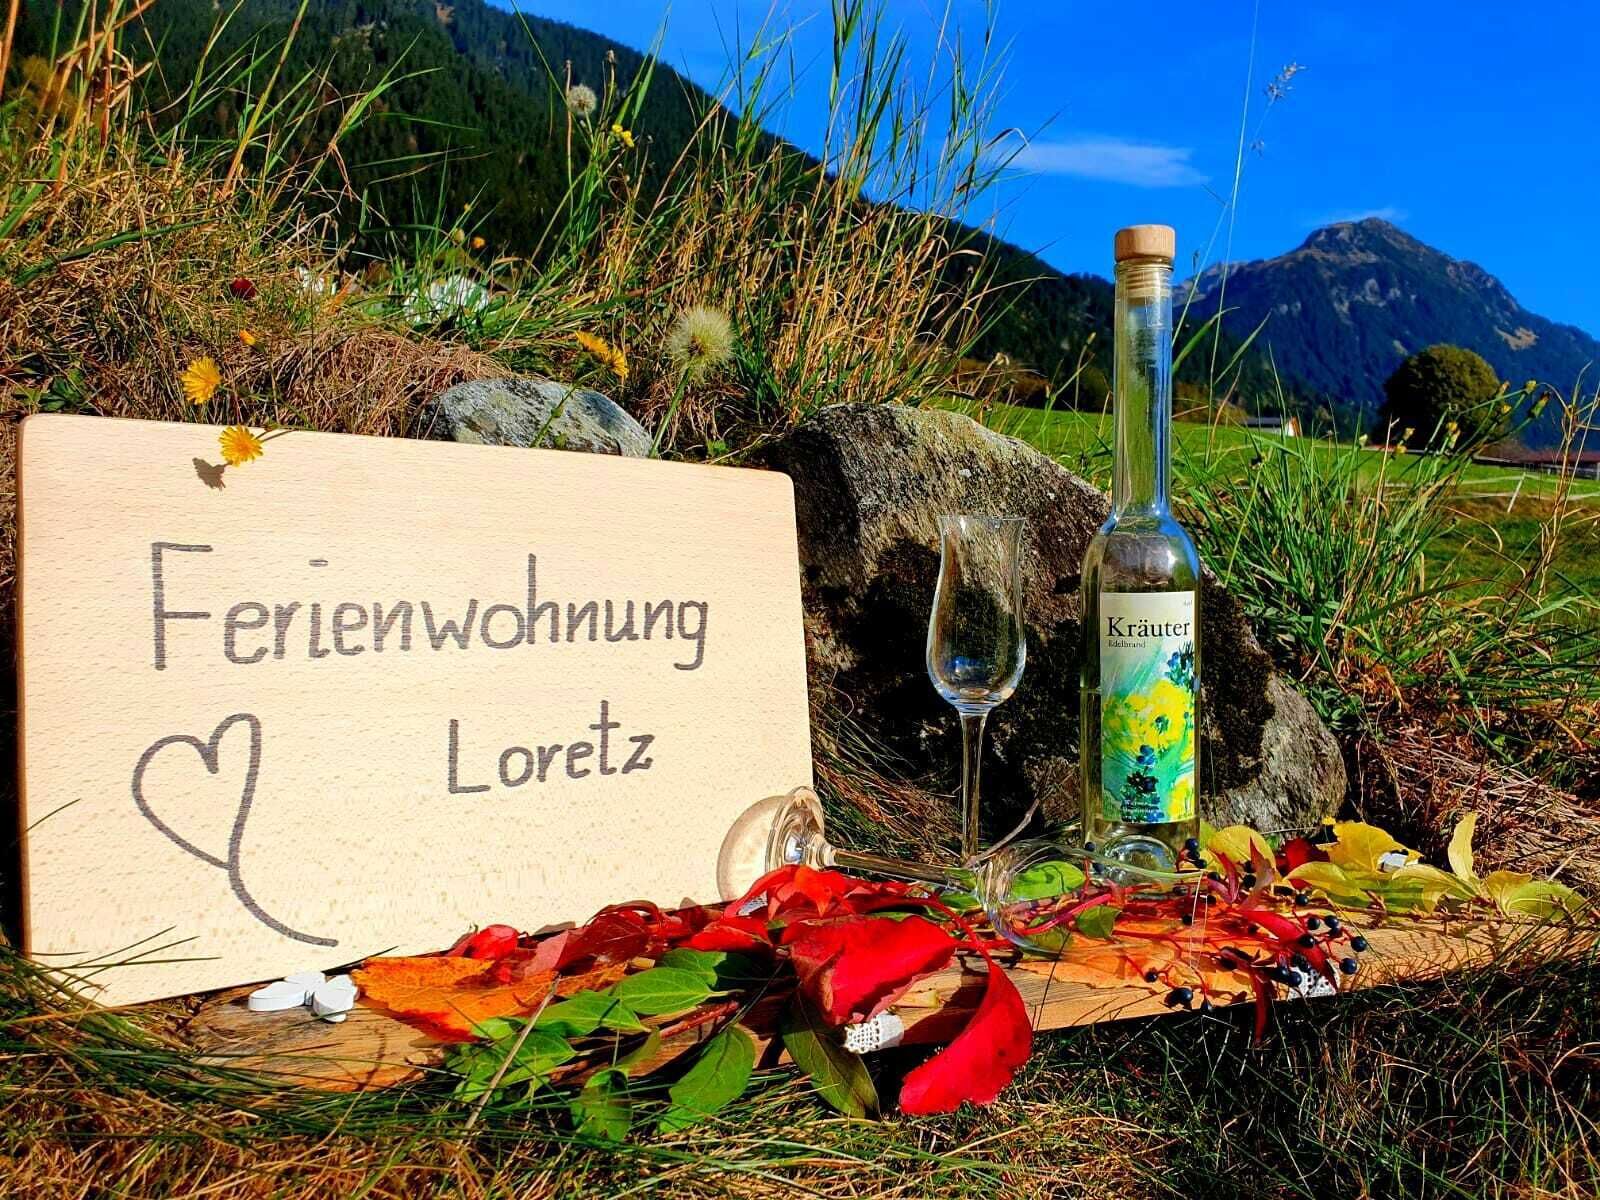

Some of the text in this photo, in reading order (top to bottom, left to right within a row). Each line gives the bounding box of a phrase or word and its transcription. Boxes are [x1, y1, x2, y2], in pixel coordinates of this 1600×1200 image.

[152, 542, 709, 671] Ferienwohnung
[1105, 616, 1190, 638] Kräuter
[447, 699, 655, 794] Loretz
